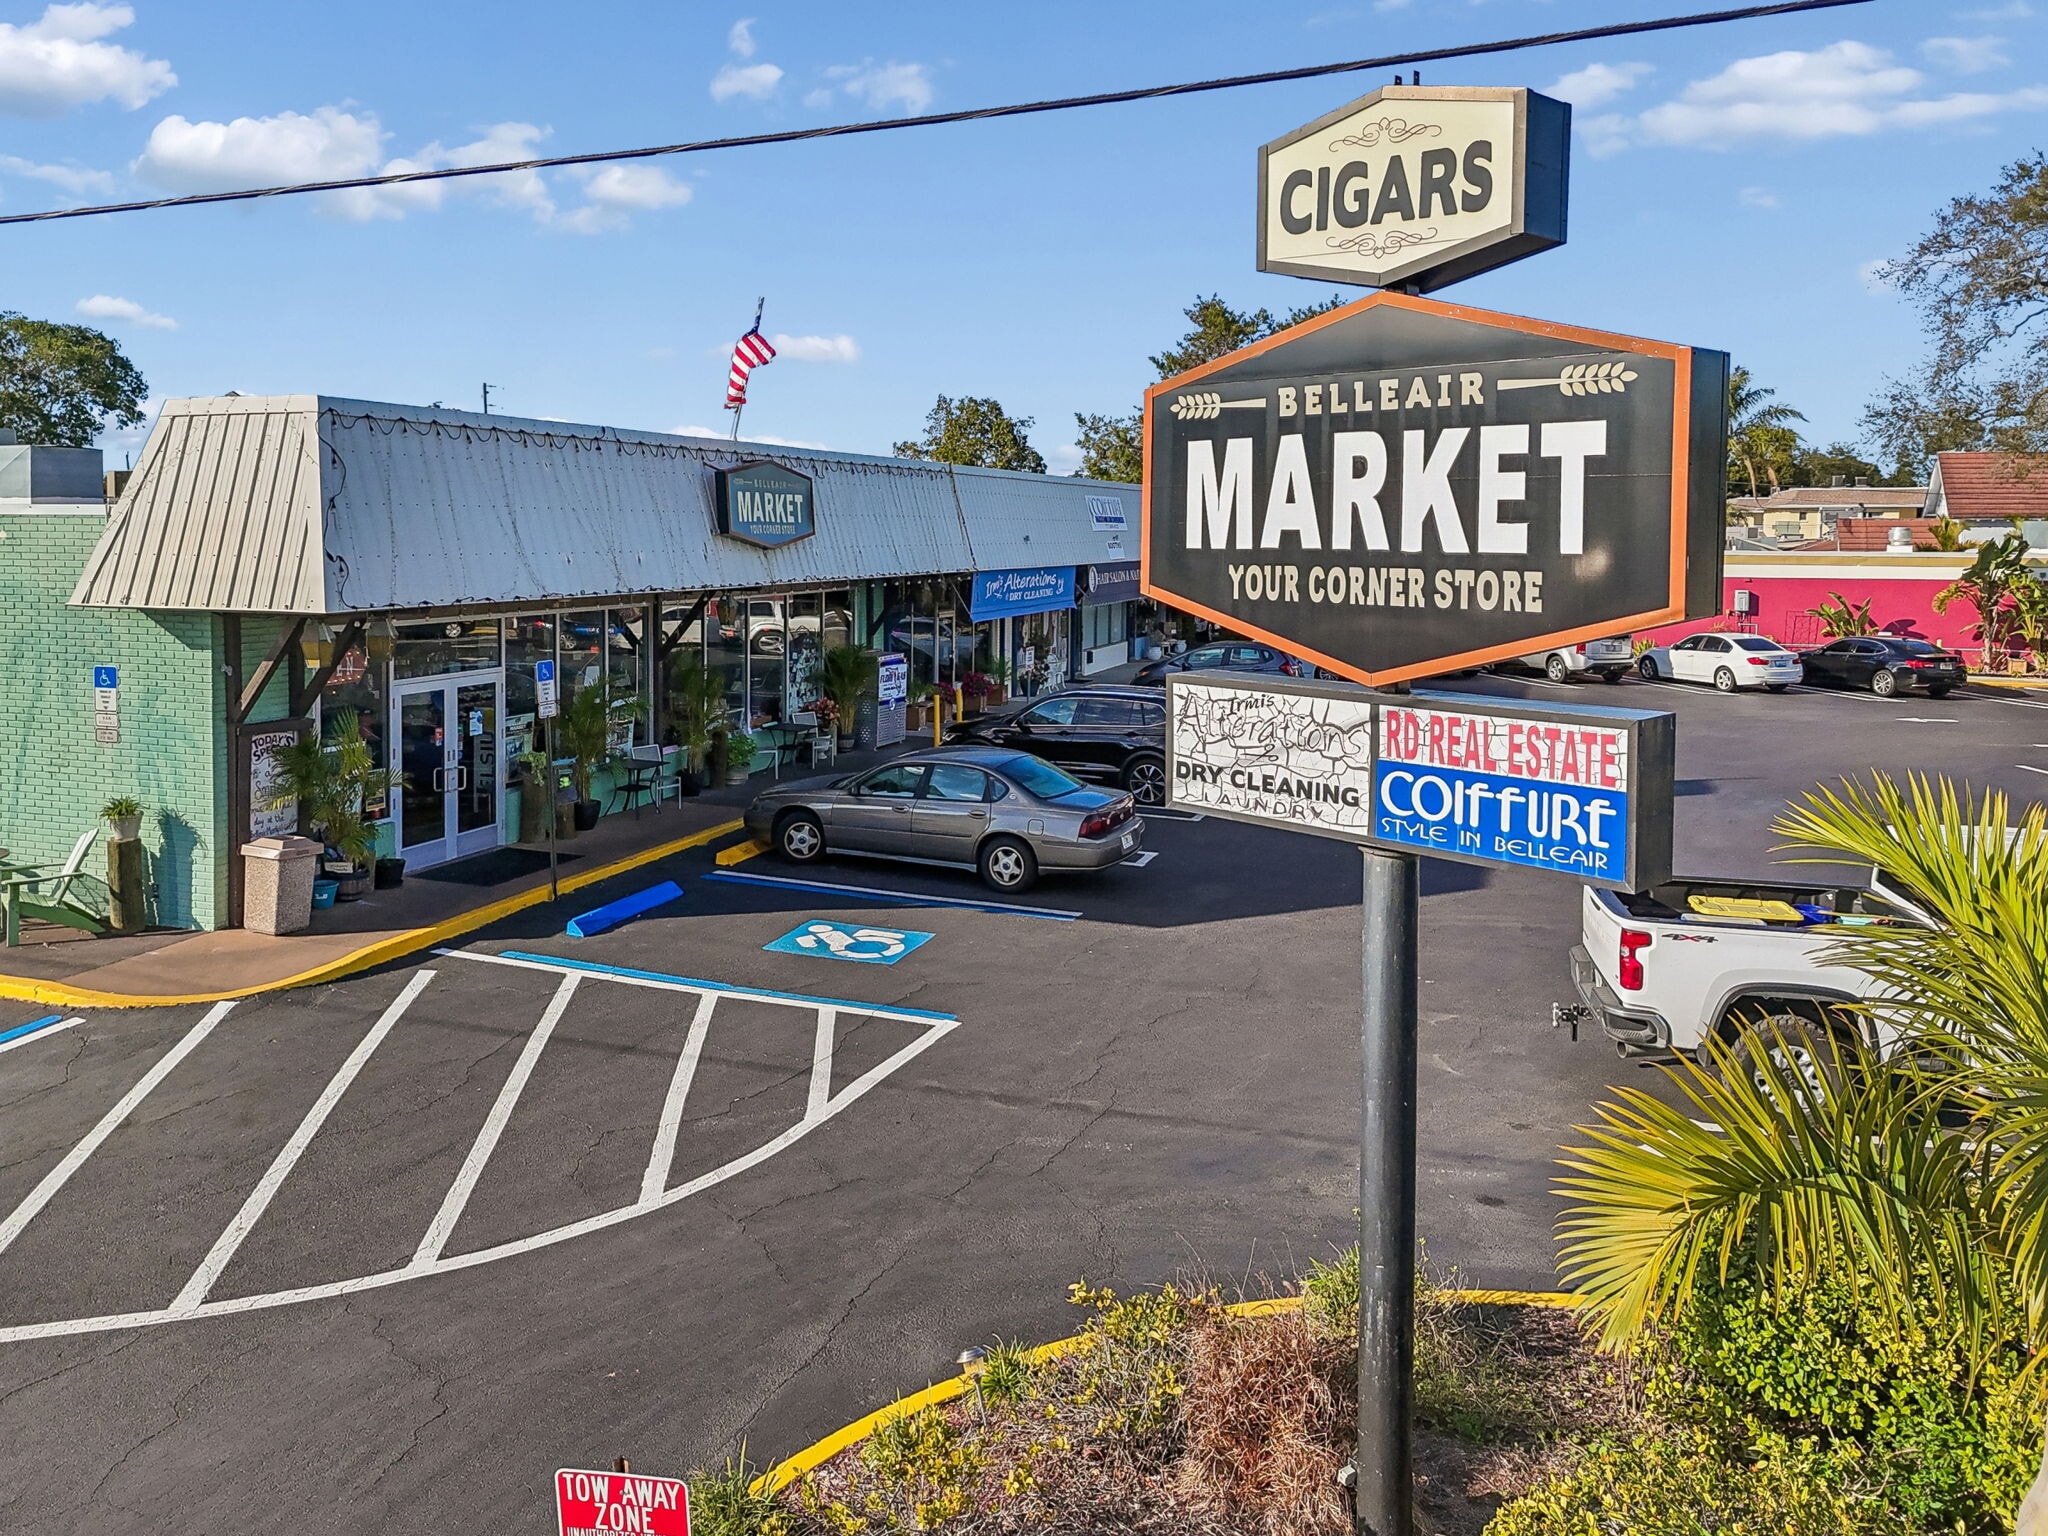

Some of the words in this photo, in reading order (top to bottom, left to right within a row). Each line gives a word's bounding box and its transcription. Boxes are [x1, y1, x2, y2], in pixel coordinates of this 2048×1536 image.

[1279, 139, 1493, 235] CIGARS
[1277, 371, 1485, 418] BELLEAIR
[737, 490, 803, 523] MARKET
[1185, 419, 1608, 556] MARKET
[1003, 570, 1057, 592] Alterations
[1009, 591, 1022, 601] DRY
[1024, 588, 1053, 600] CLEANING
[1109, 570, 1126, 583] SALON
[1130, 569, 1141, 580] NAI
[1228, 563, 1300, 603] YOUR
[1308, 566, 1425, 609] CORNER
[1433, 568, 1543, 614] STORE
[1229, 694, 1275, 716] Irmi's
[251, 732, 295, 750] TODAY'S
[1177, 694, 1369, 756] Alterations
[1386, 710, 1419, 760] RD
[1429, 714, 1497, 772] REAL
[1508, 723, 1617, 788] ESTATE
[1176, 760, 1225, 784] DRY
[1230, 769, 1361, 808] CLEANING
[1204, 792, 1323, 820] LAUNDRY
[1380, 770, 1617, 849] COIFFURE
[1381, 817, 1448, 842] STYLE
[1460, 830, 1481, 848] IN
[1494, 837, 1608, 870] BELLEAIR
[1661, 933, 1719, 943] 4X4
[562, 1473, 609, 1503] TOW
[621, 1478, 680, 1511] AWAY
[594, 1503, 655, 1534] ZONE
